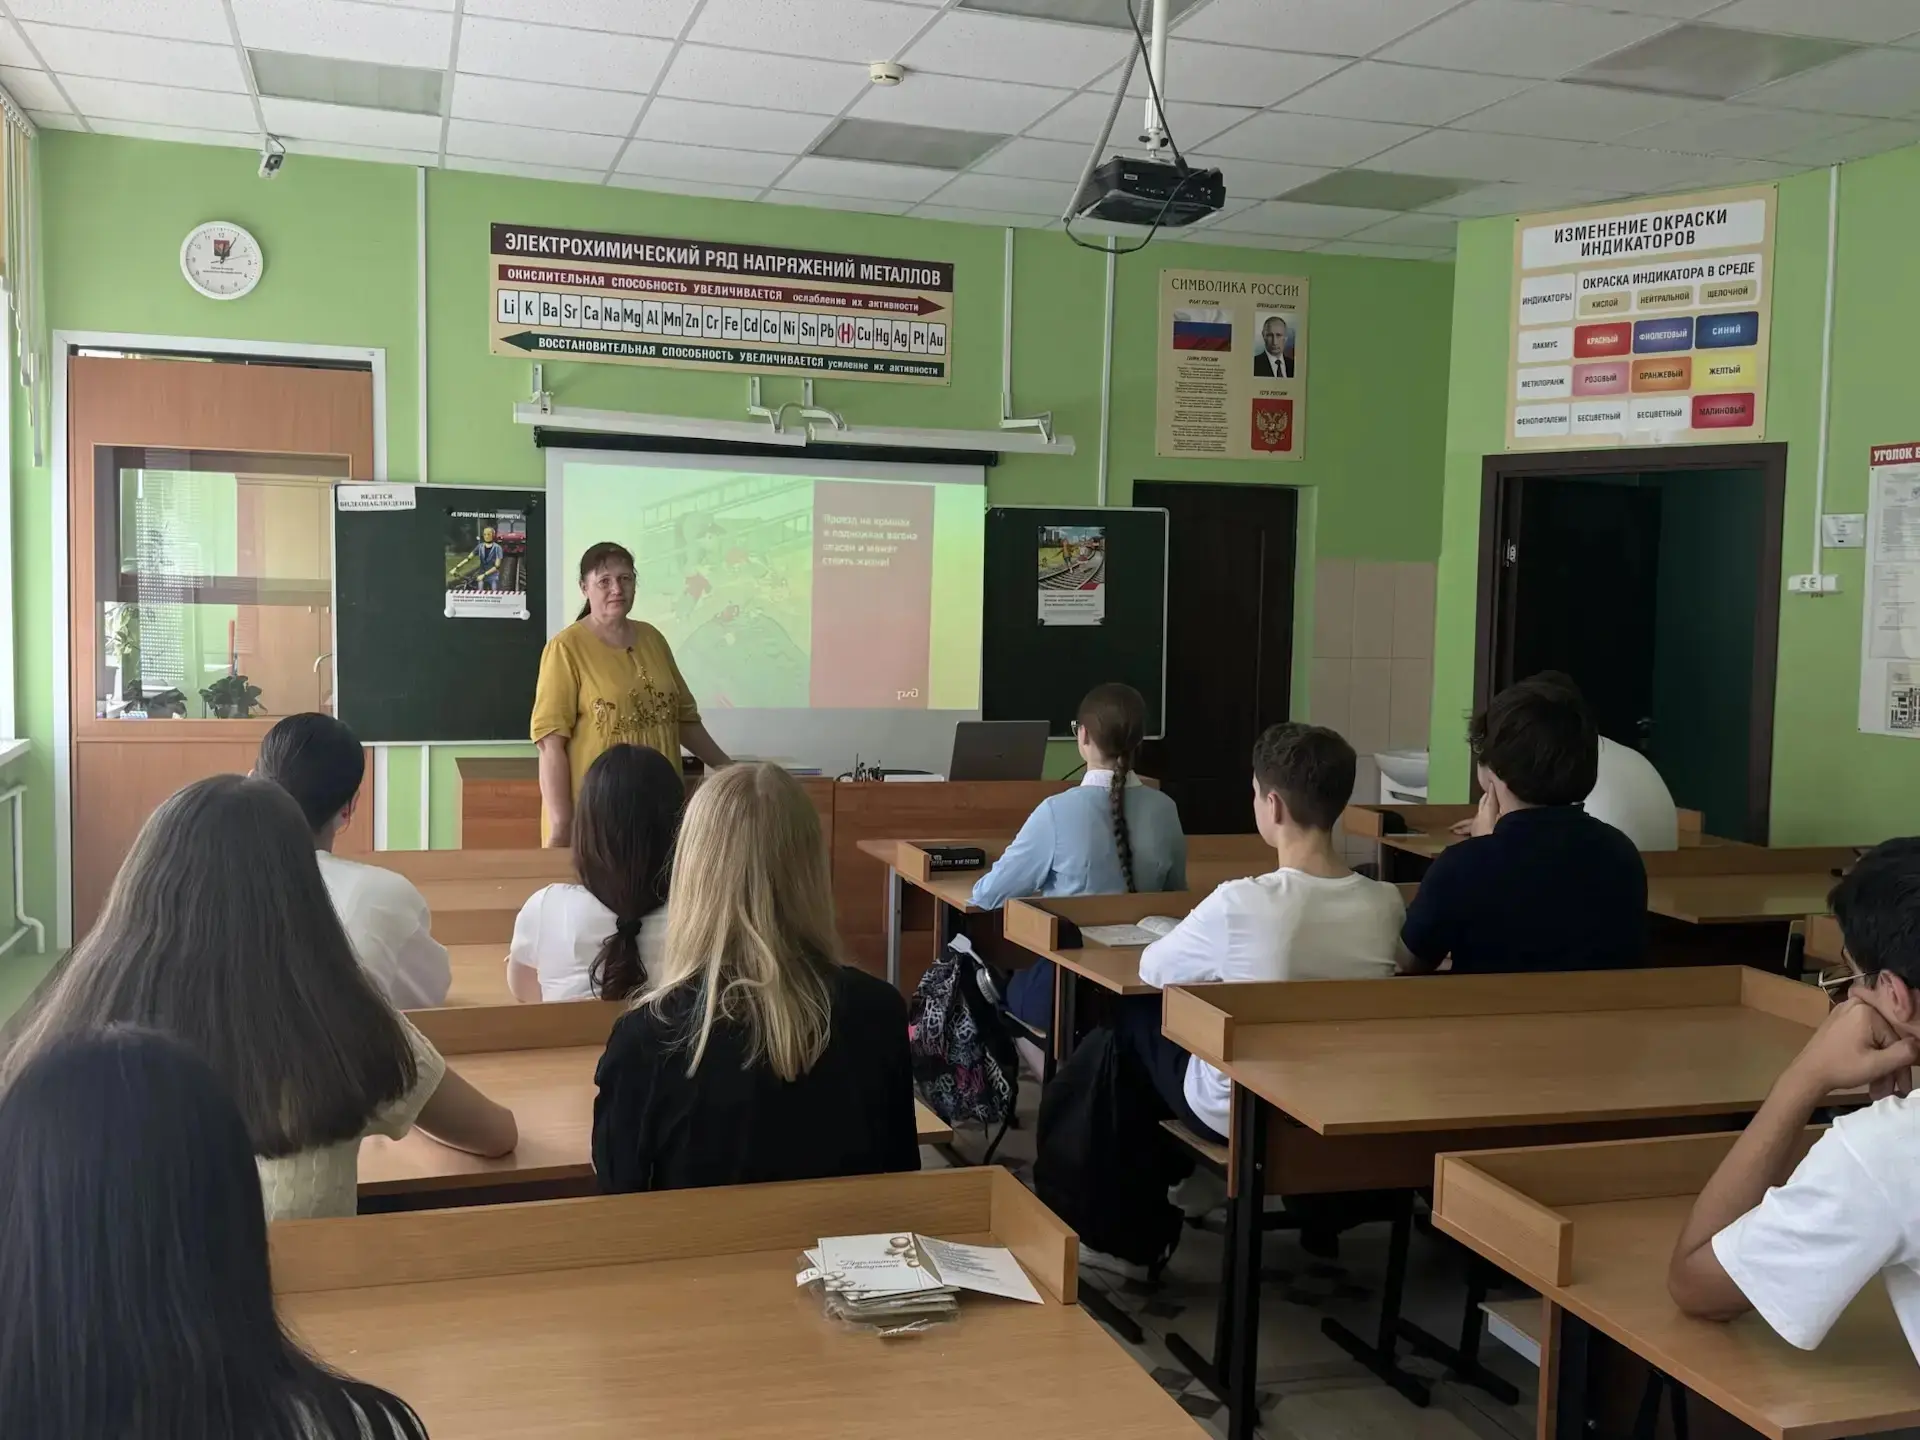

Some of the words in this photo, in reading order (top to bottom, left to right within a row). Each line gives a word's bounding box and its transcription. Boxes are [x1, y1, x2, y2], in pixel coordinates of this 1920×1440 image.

[1554, 218, 1648, 243] ИЗМЕНЕНИЕ
[1653, 209, 1727, 231] ОКРАСКИ
[1581, 230, 1695, 257] ИНДИКАТОРОВ
[505, 232, 700, 266] ЭЛЕКТРОХИМИЧЕСКИЙ
[705, 250, 738, 271] РЯД
[744, 254, 856, 279] НАПРЯЖЕНИЙ
[860, 263, 941, 286] МЕТАЛЛОВ
[1582, 274, 1630, 290] ОКРАСКА
[1632, 266, 1704, 284] ИНДИКАТОРА
[1708, 266, 1715, 277] В
[1718, 262, 1755, 276] СРЕДЕ
[508, 268, 605, 286] ОКИСЛИТЕЛЬНАЯ
[611, 277, 688, 293] СПОСОБНОСТЬ
[693, 283, 782, 300] УВЕЛИЧИВАЕТСЯ
[793, 293, 847, 306] ослабление
[852, 298, 862, 307] их
[868, 300, 919, 312] активности
[1172, 278, 1246, 294] СИМВОЛИКА
[1251, 283, 1299, 297] РОССИИ
[1707, 286, 1748, 298] ЩЕЛОЧНОЙ
[1522, 292, 1572, 306] ИНДИКАТОРЫ
[1591, 298, 1619, 309] КИСЛОЙ
[1640, 291, 1690, 304] НЕЙТРАЛЬНОЙ
[504, 299, 514, 315] Li
[525, 300, 533, 316] K
[543, 302, 558, 318] Ba
[564, 304, 578, 319] Sr
[584, 306, 599, 321] Ca
[604, 307, 620, 323] Na
[624, 309, 641, 327] Mg
[646, 310, 658, 326] Al
[664, 312, 681, 327] Mn
[686, 313, 699, 329] Zn
[706, 315, 719, 330] Cr
[725, 316, 738, 331] Fe
[744, 317, 758, 333] Cd
[763, 319, 777, 334] Co
[784, 320, 795, 335] Ni
[802, 321, 815, 337] Sn
[821, 323, 834, 338] Pb
[857, 326, 871, 341] Cu
[876, 327, 889, 345] Hg
[894, 329, 907, 346] Ag
[914, 330, 925, 345] Pt
[930, 331, 943, 347] Au
[1639, 328, 1688, 341] ФИОЛЕТОВЫЙ
[1712, 324, 1741, 336] СИНИЙ
[1532, 340, 1558, 350] ЛАКМУС
[1587, 334, 1619, 345] КРАСНЫЙ
[538, 337, 656, 356] ВОССТАНОВИТЕЛЬНАЯ
[662, 346, 734, 361] СПОСОБНОСТЬ
[740, 351, 824, 367] УВЕЛИЧИВАЕТСЯ
[828, 360, 869, 371] усиление
[874, 363, 884, 372] их
[889, 364, 938, 375] активности
[1639, 369, 1683, 380] ОРАНЖЕВЫЙ
[1709, 364, 1741, 375] ЖЕЛТЫЙ
[1521, 377, 1565, 388] МЕТИЛОРАНЖ
[1584, 373, 1617, 384] РОЗОВЫЙ
[1637, 408, 1683, 420] БЕСЦВЕТНЫЙ
[1699, 404, 1746, 416] МАЛИНОВЫЙ
[1577, 411, 1621, 423] БЕСЦВЕТНЫЙ
[1874, 447, 1913, 462] УГОЛОК
